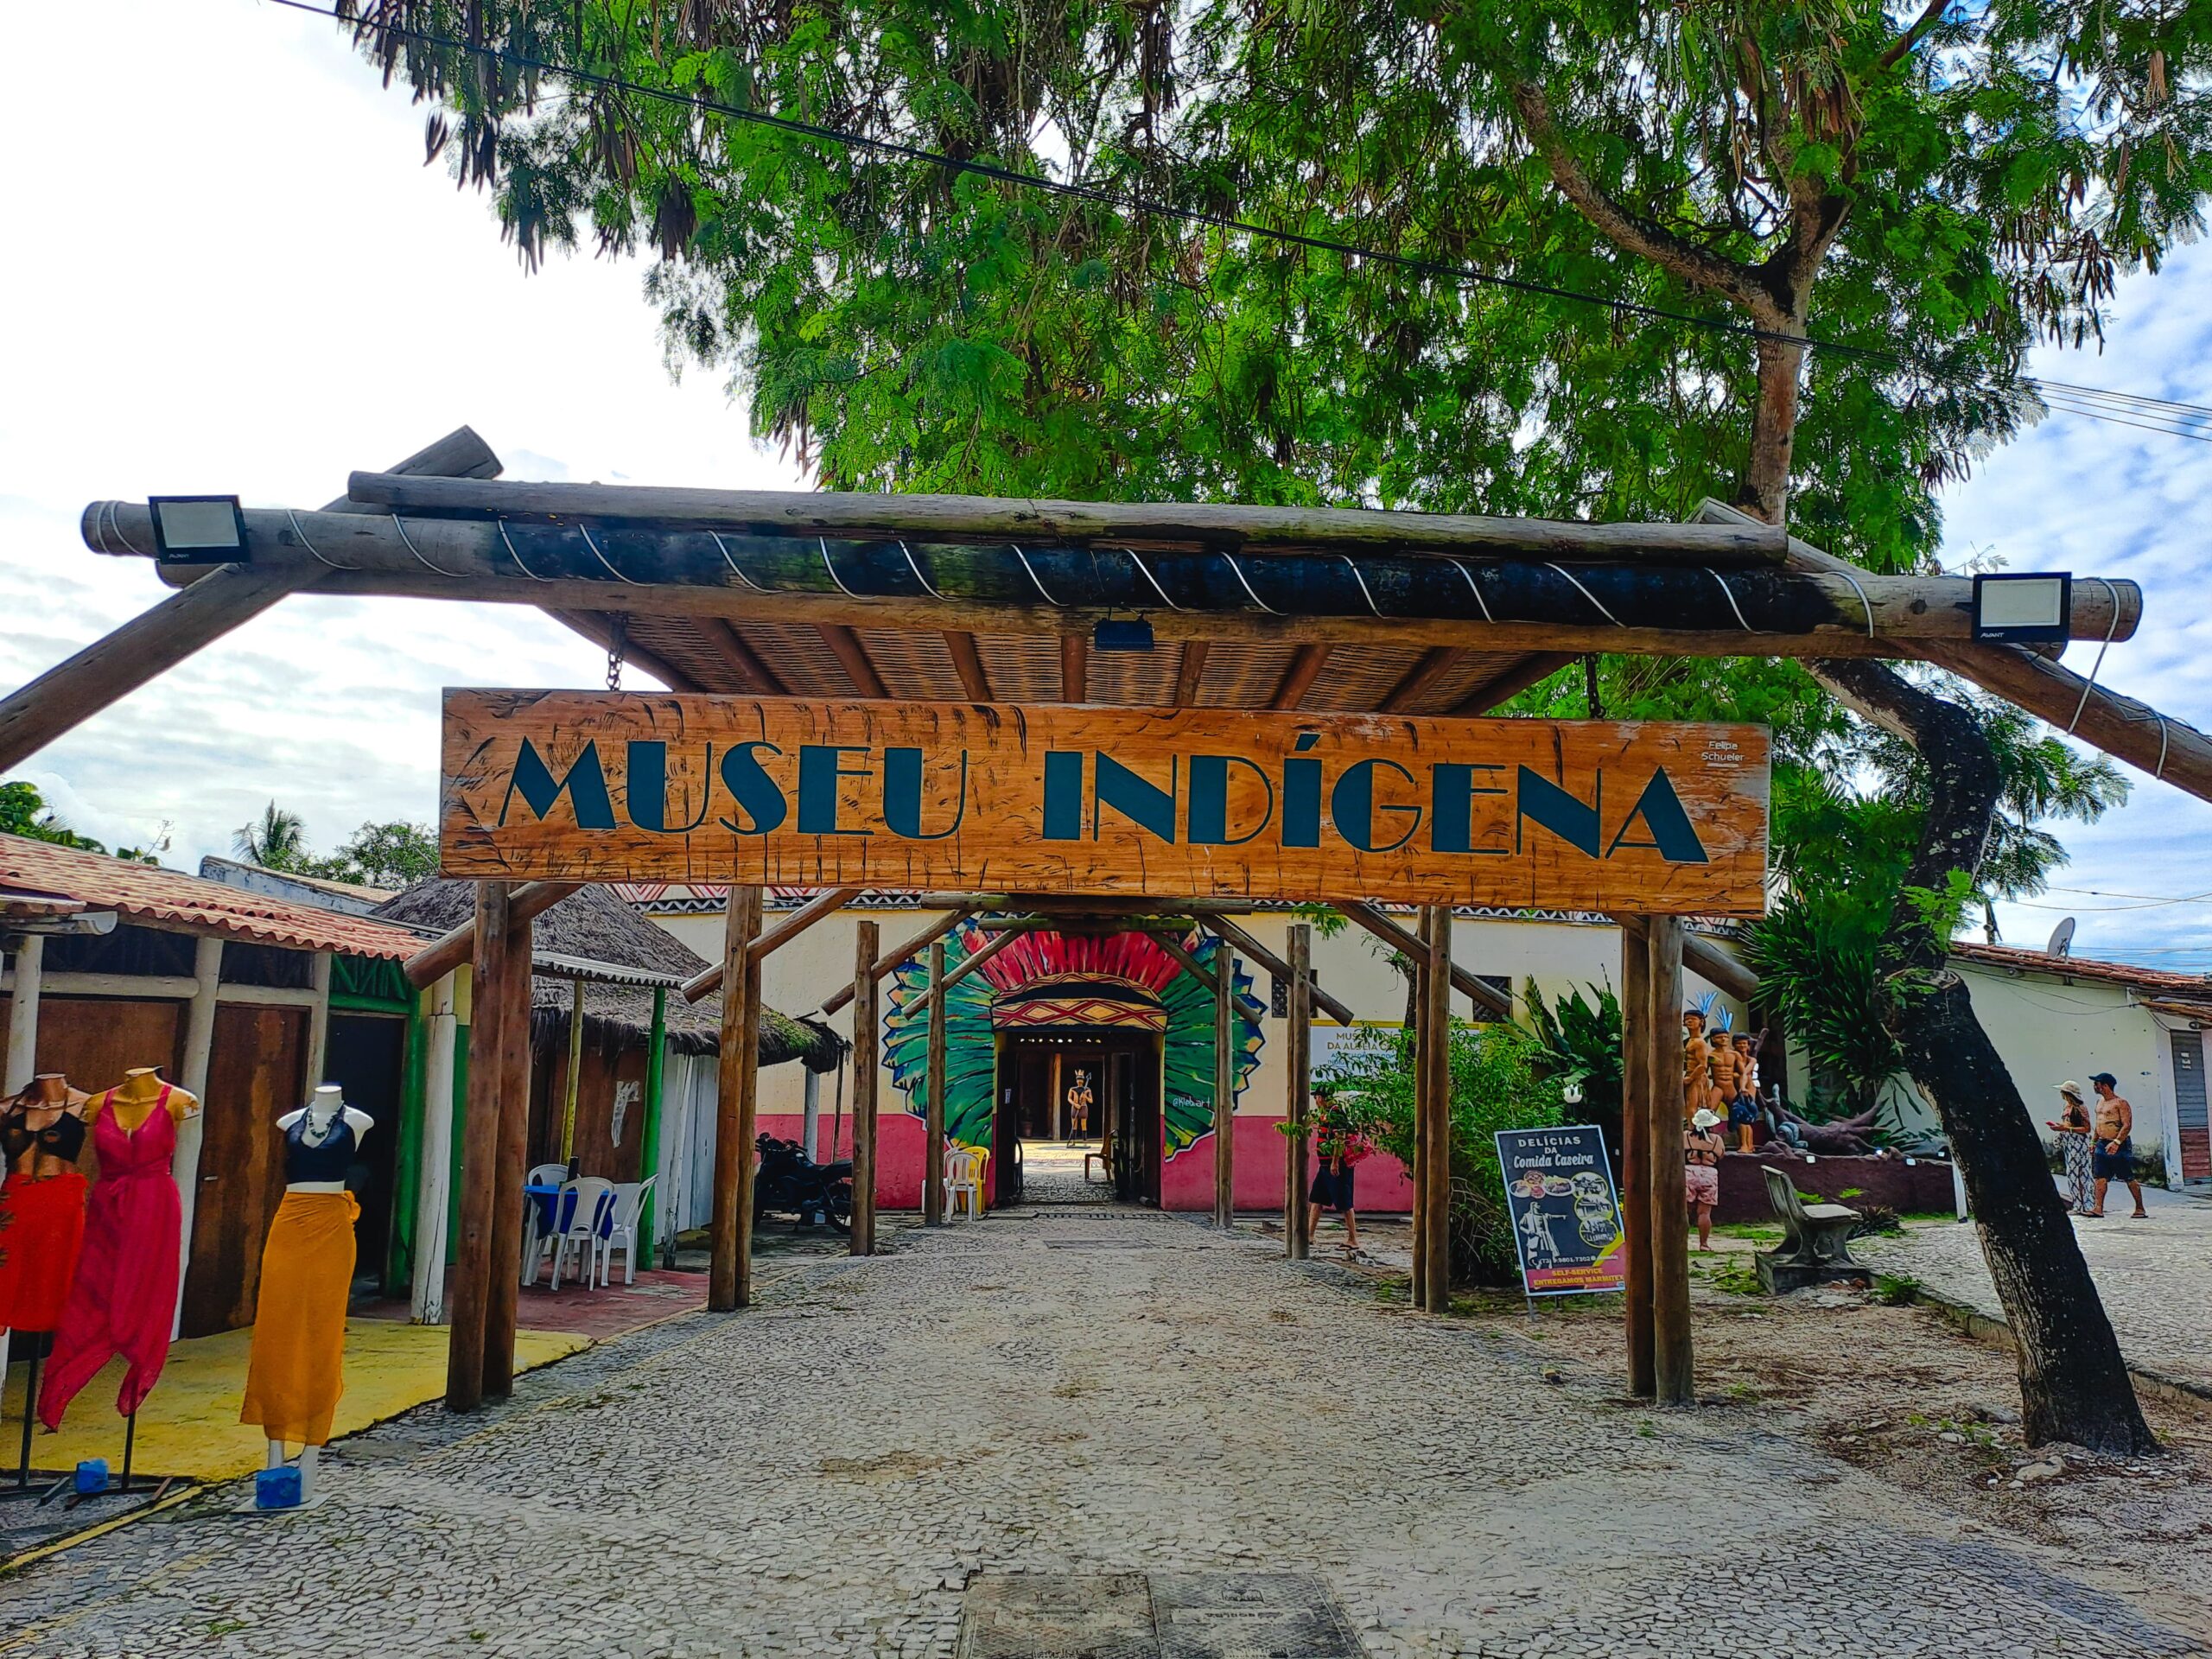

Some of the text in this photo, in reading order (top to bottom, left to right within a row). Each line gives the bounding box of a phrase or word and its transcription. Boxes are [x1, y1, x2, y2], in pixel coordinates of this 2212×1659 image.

[1708, 741, 1738, 751] Felipe
[1700, 752, 1745, 761] Schueler
[498, 733, 1710, 862] MUSEU INDÍGENA
[1517, 1135, 1581, 1147] DELÍCIAS
[1514, 1153, 1594, 1168] Comida Caseira
